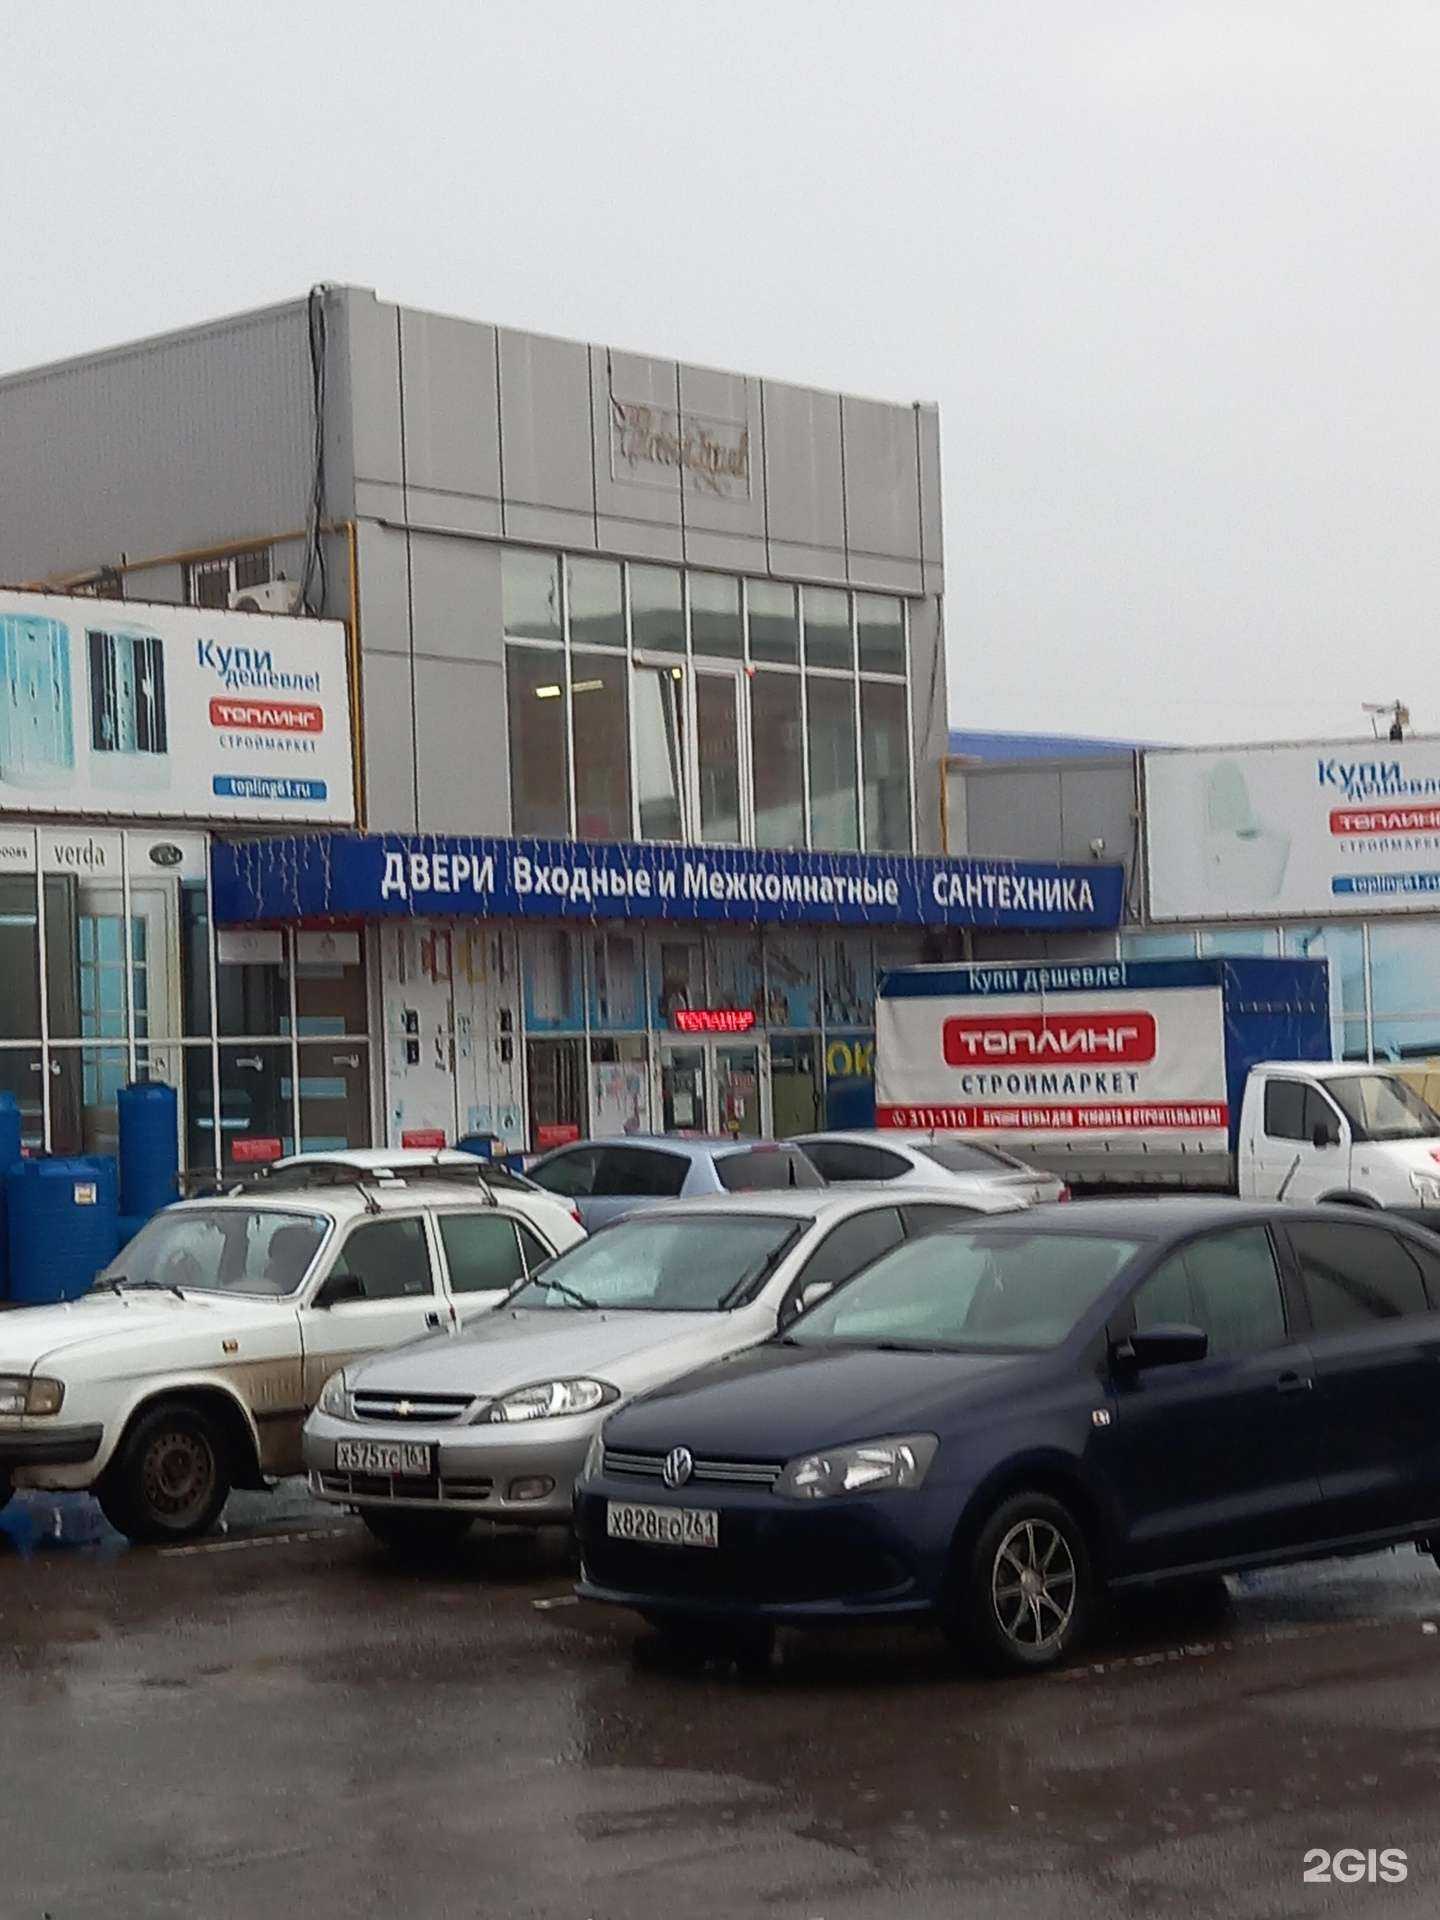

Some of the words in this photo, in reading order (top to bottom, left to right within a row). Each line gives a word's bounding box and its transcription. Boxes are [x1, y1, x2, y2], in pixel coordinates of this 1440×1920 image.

[197, 638, 272, 677] Купи
[225, 669, 320, 692] дешевле!
[218, 705, 316, 727] ТОПЛИНГ
[1318, 759, 1400, 793] Купи
[1347, 778, 1440, 801] дешевл
[1339, 811, 1440, 830] ТОПЛИН
[54, 837, 105, 871] verda
[381, 852, 495, 900] ДВЕРИ
[513, 856, 651, 903] Входные
[658, 866, 675, 898] и
[683, 861, 899, 905] Межкомнатные
[932, 871, 1095, 912] САНТЕХНИКА
[969, 966, 1018, 995] Купи
[1024, 962, 1127, 993] дешевле!
[960, 1027, 1138, 1056] ТОПЛИНГ
[826, 1040, 875, 1076] ОК
[962, 1070, 1139, 1096] СТРОЙМАРКЕТ
